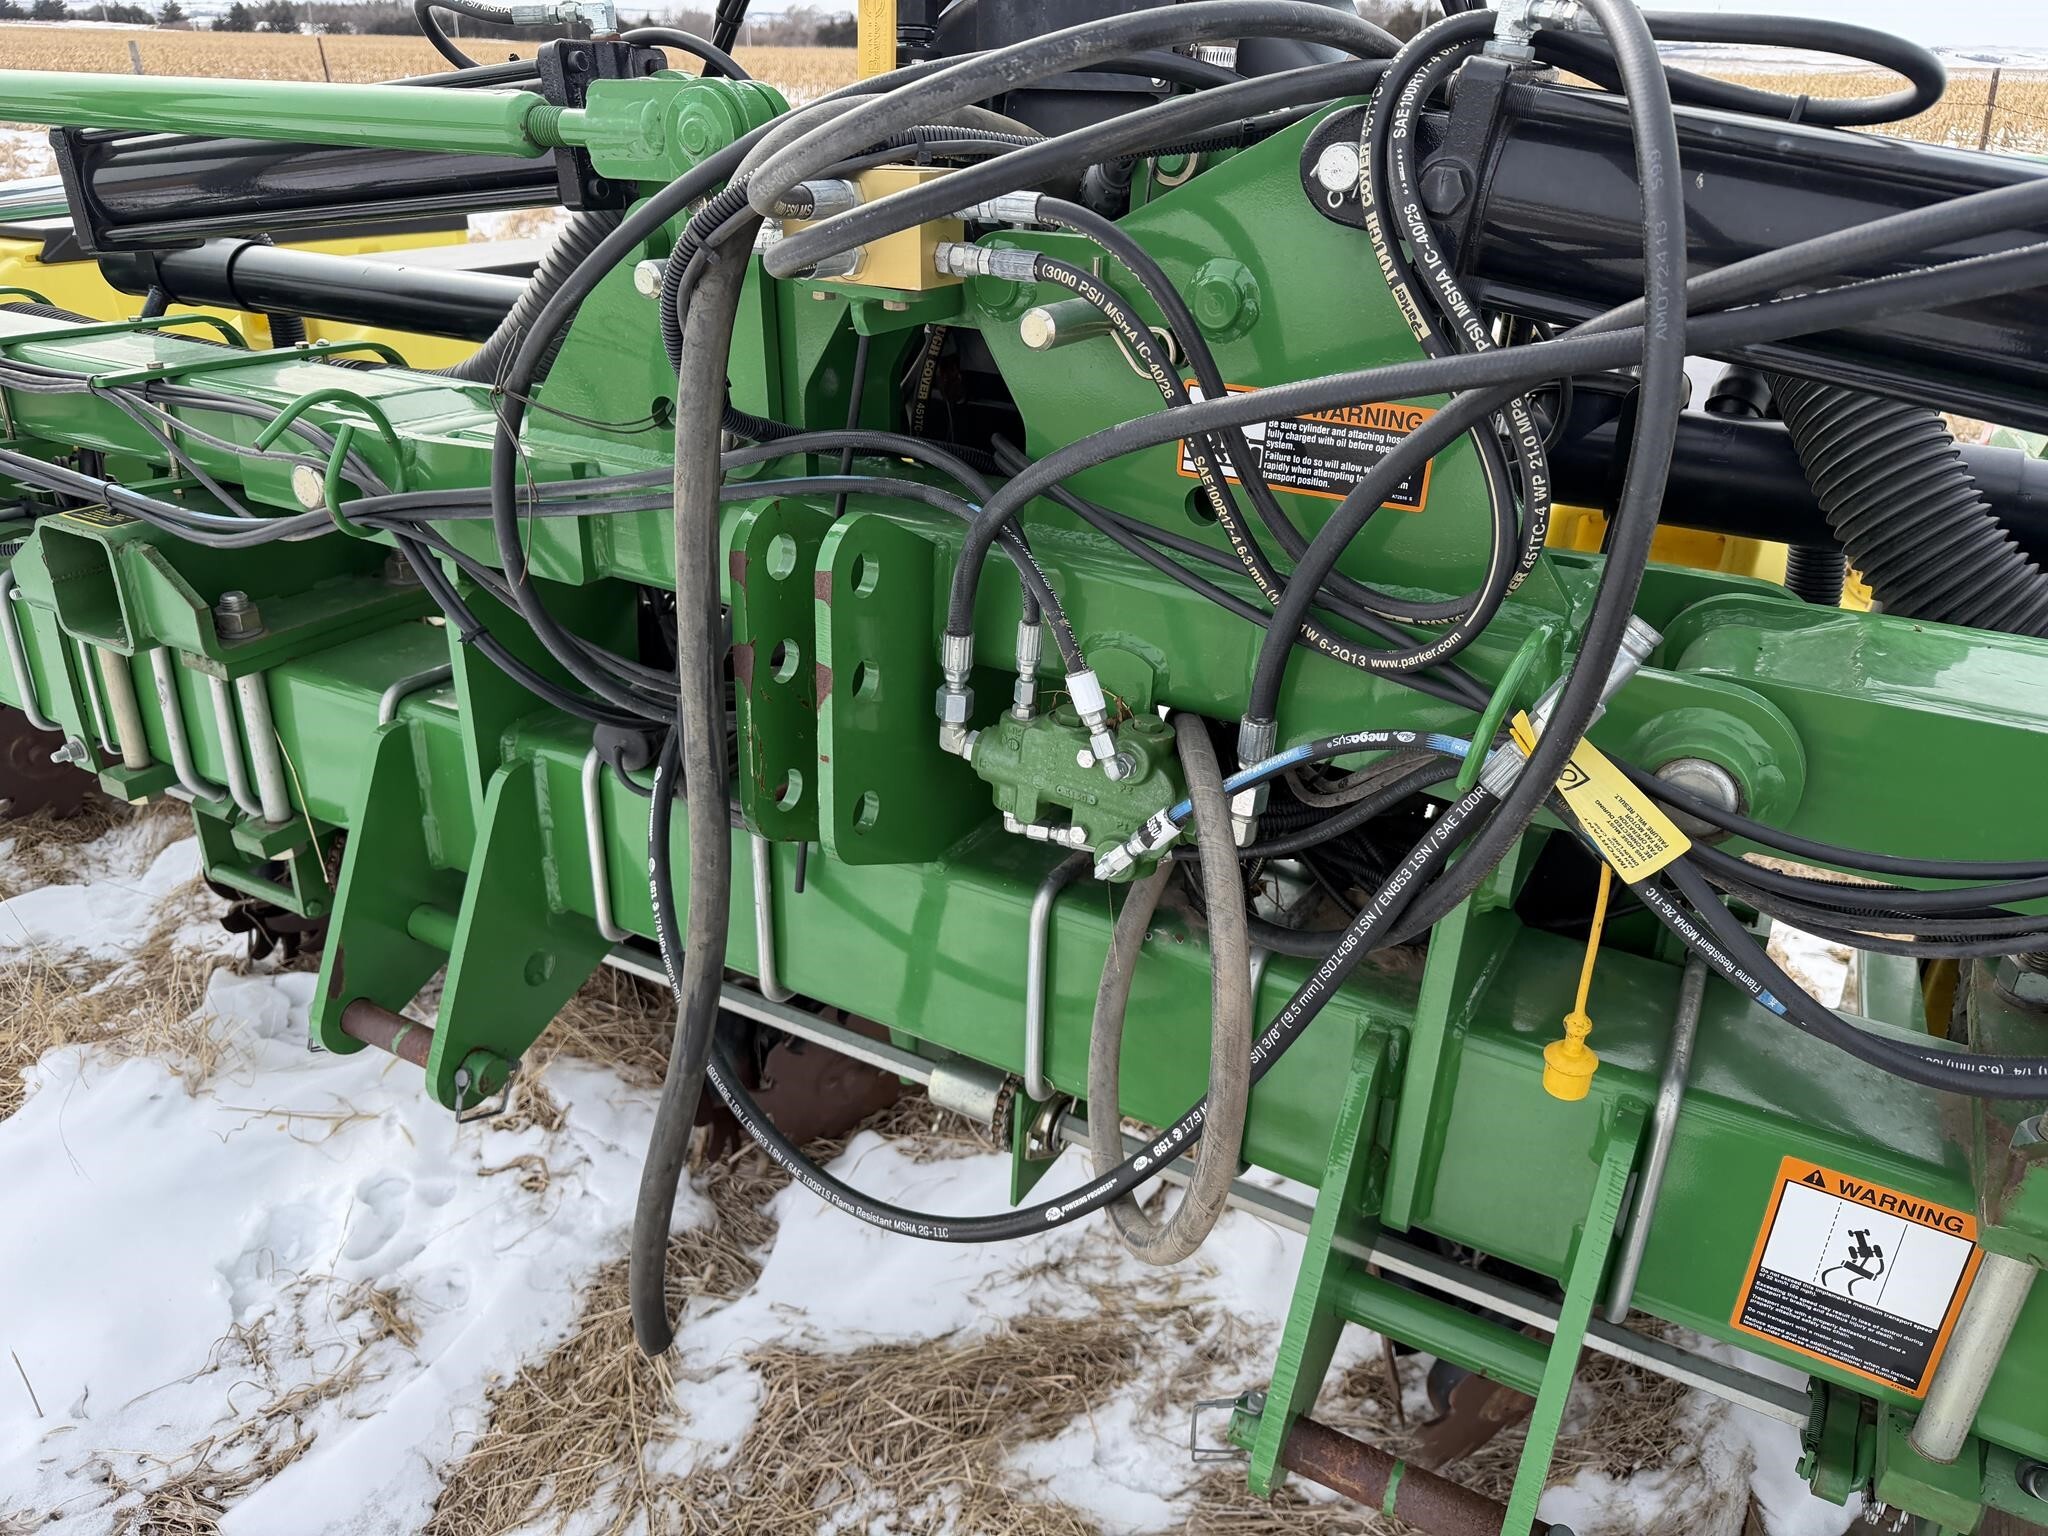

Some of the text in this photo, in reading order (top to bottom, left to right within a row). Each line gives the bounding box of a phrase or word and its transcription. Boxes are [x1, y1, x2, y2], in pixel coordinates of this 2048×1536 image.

[1359, 141, 1375, 209] COVER
[1435, 268, 1471, 319] MSHA
[1042, 263, 1176, 400] (3000 PSI) MSHA IC-40/26
[1462, 317, 1490, 353] PSI)
[1280, 421, 1297, 430] sure
[1298, 423, 1330, 436] cylinder
[1331, 427, 1345, 437] and
[1347, 429, 1384, 443] attaching
[1311, 405, 1424, 431] WARNING
[1511, 397, 1533, 434] MPa
[1265, 439, 1295, 452] system.
[1267, 428, 1373, 451] fully charged with oil before
[1262, 469, 1330, 489] transport position.
[1263, 459, 1354, 483] rapidly when attempting
[1264, 449, 1362, 472] Failure to do so will allow
[1532, 475, 1548, 502] WP
[1194, 455, 1243, 545] SAE100R17-4
[1248, 565, 1268, 590] mm
[1522, 506, 1547, 569] 451TC-4
[1370, 631, 1462, 670] www.parker.com
[1435, 814, 1460, 840] SAE
[1594, 798, 1653, 859] BE CONNECTED DURING
[1606, 818, 1647, 861] THIS HOSE MUST
[1613, 792, 1669, 849] FAILURE WILL RESULT.
[1617, 813, 1658, 856] FAN OPERATION
[1624, 812, 1663, 852] OR FAN MOTOR
[1408, 844, 1433, 871] 1SN
[1430, 836, 1440, 849] /
[1378, 868, 1413, 907] EN853
[1354, 910, 1377, 937] 1SN
[1374, 902, 1383, 916] /
[1318, 933, 1359, 982] ISO1436
[1645, 887, 1762, 994] Flame Resistant MSHA 2G-11C
[1181, 1110, 1203, 1134] 17.9
[768, 1144, 784, 1163] 1SN
[787, 1160, 802, 1178] SAE
[831, 1193, 856, 1214] Flame
[855, 1206, 893, 1229] Resistant
[893, 1218, 918, 1235] MSHA
[917, 1224, 950, 1239] 2G-11C
[1838, 1179, 1965, 1234] WARNING
[1754, 1285, 1781, 1298] transport
[1812, 1306, 1824, 1314] and
[1755, 1280, 1786, 1295] Exceeding
[1798, 1296, 1817, 1307] speed
[1818, 1304, 1831, 1312] may
[1879, 1326, 1902, 1338] control
[1902, 1334, 1923, 1346] during
[1780, 1275, 1801, 1286] exceed
[1802, 1282, 1814, 1290] this
[1883, 1312, 1912, 1327] transport
[1912, 1323, 1932, 1334] speed
[1751, 1293, 1779, 1307] Transport
[1793, 1309, 1807, 1317] with
[1888, 1344, 1901, 1352] and
